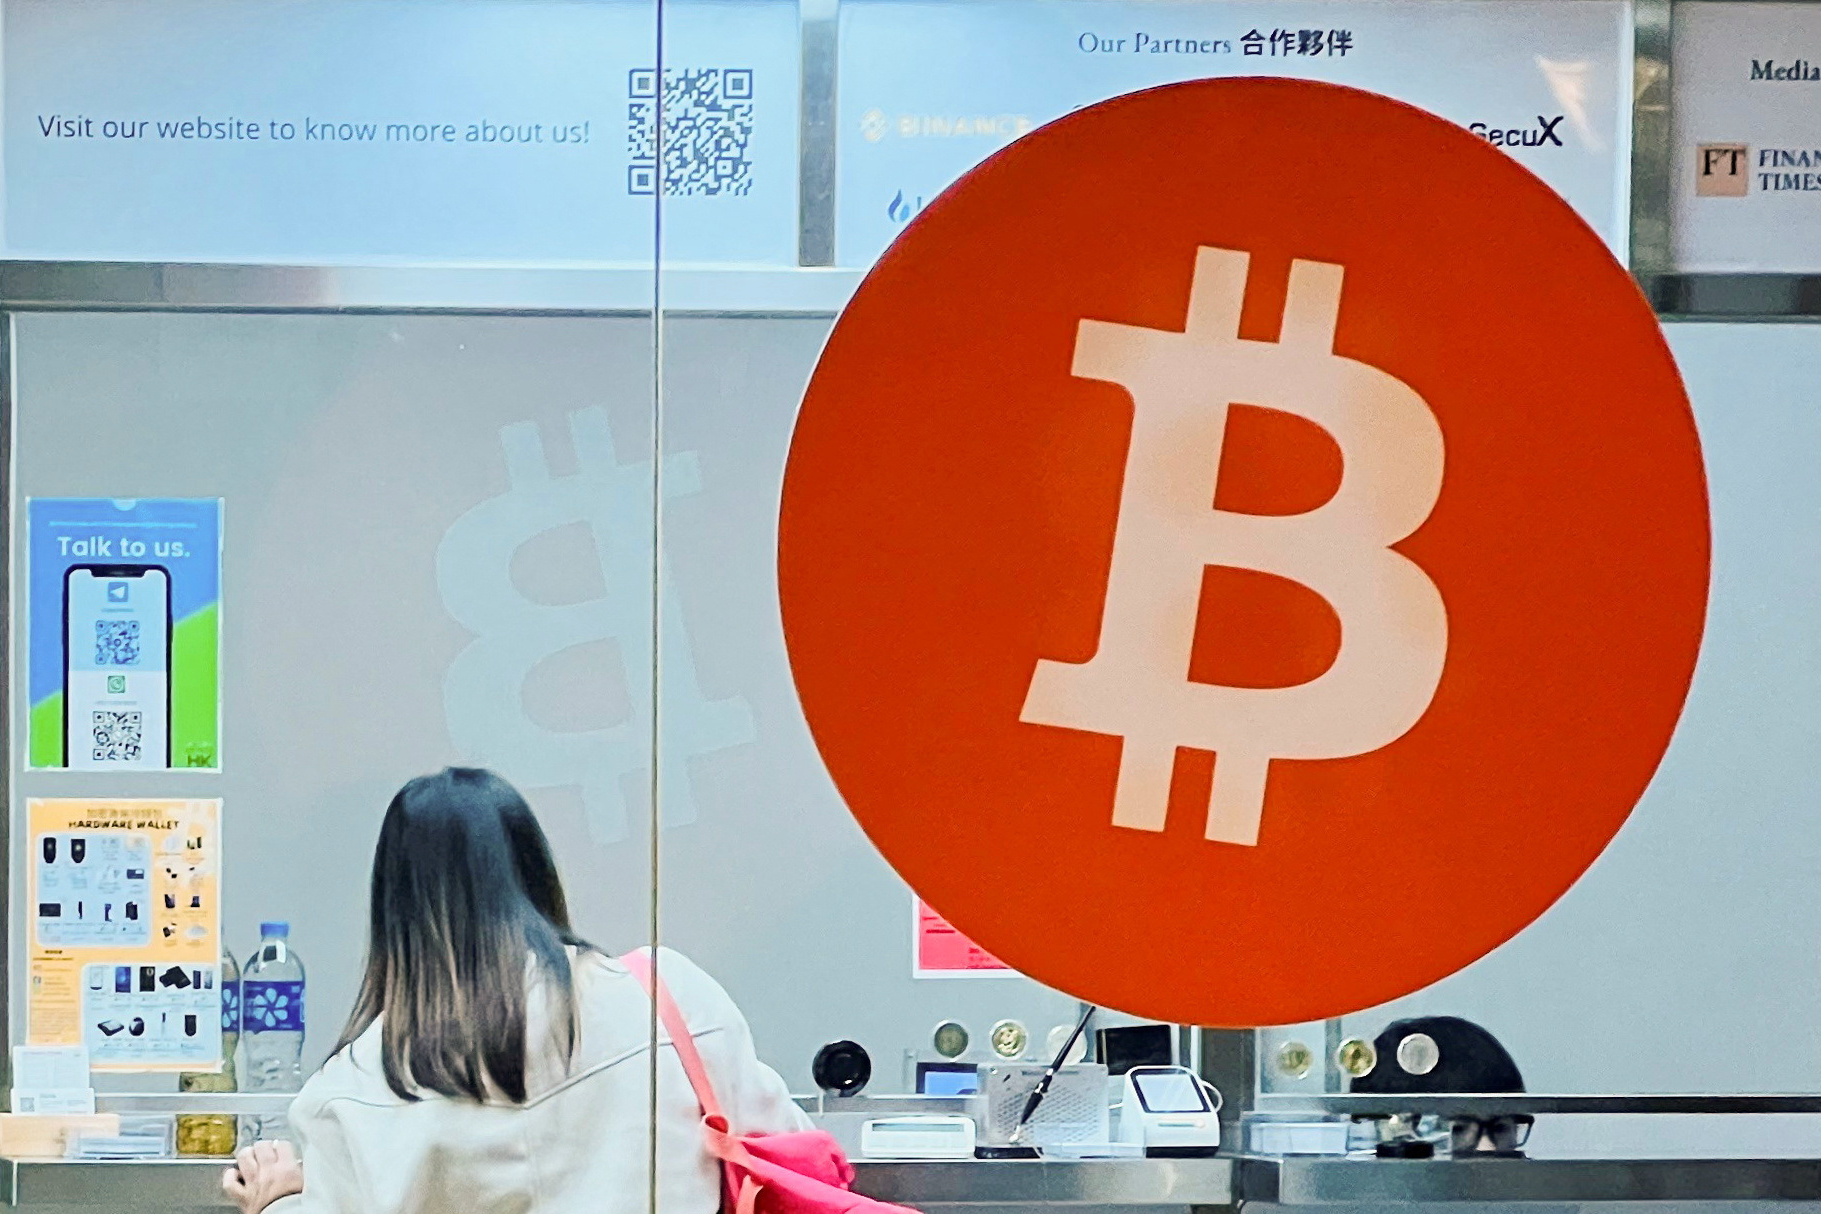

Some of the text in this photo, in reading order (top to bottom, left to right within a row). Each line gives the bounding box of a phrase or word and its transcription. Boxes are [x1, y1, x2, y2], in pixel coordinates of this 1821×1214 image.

[1079, 32, 1126, 53] Our
[1134, 32, 1232, 55] Partners
[38, 114, 590, 144] Visit our website to know more about us!
[1703, 149, 1747, 176] FT
[57, 535, 191, 558] Talk to us.
